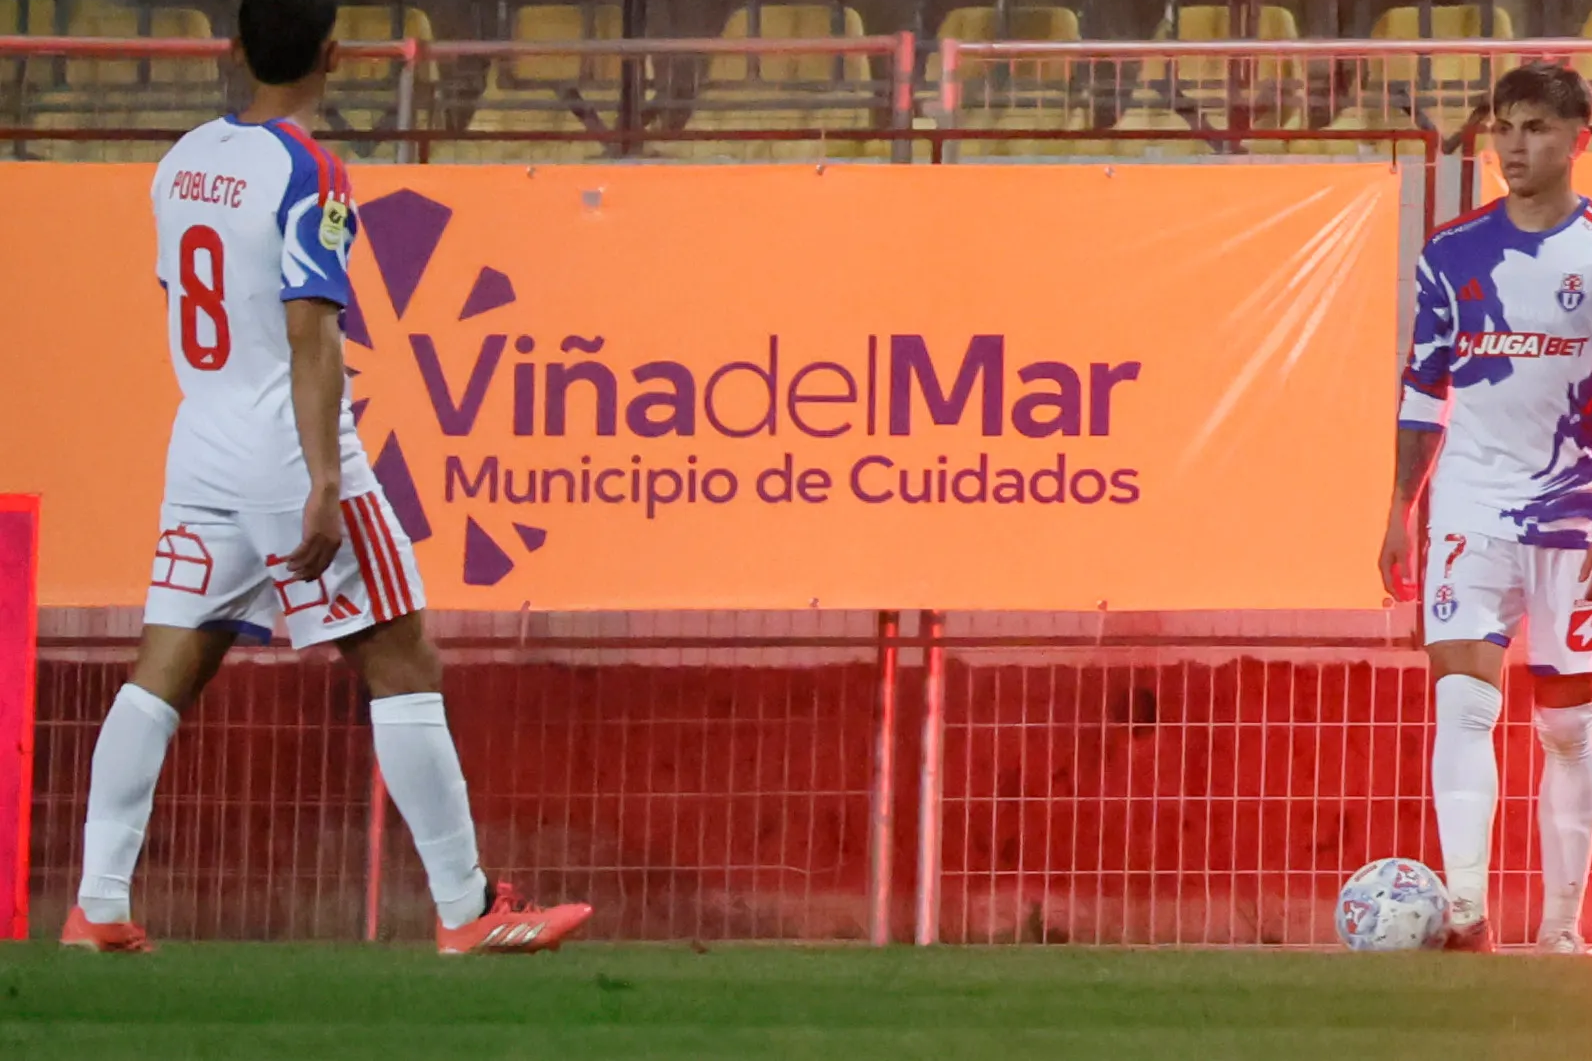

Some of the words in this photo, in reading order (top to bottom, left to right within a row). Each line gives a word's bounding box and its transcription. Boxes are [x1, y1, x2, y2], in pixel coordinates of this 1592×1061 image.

[168, 169, 247, 209] POBLETE
[179, 224, 231, 372] 8
[445, 454, 738, 519] Municipio
[756, 453, 830, 505] de
[850, 453, 1142, 505] Cuidados
[1444, 533, 1467, 579] 7
